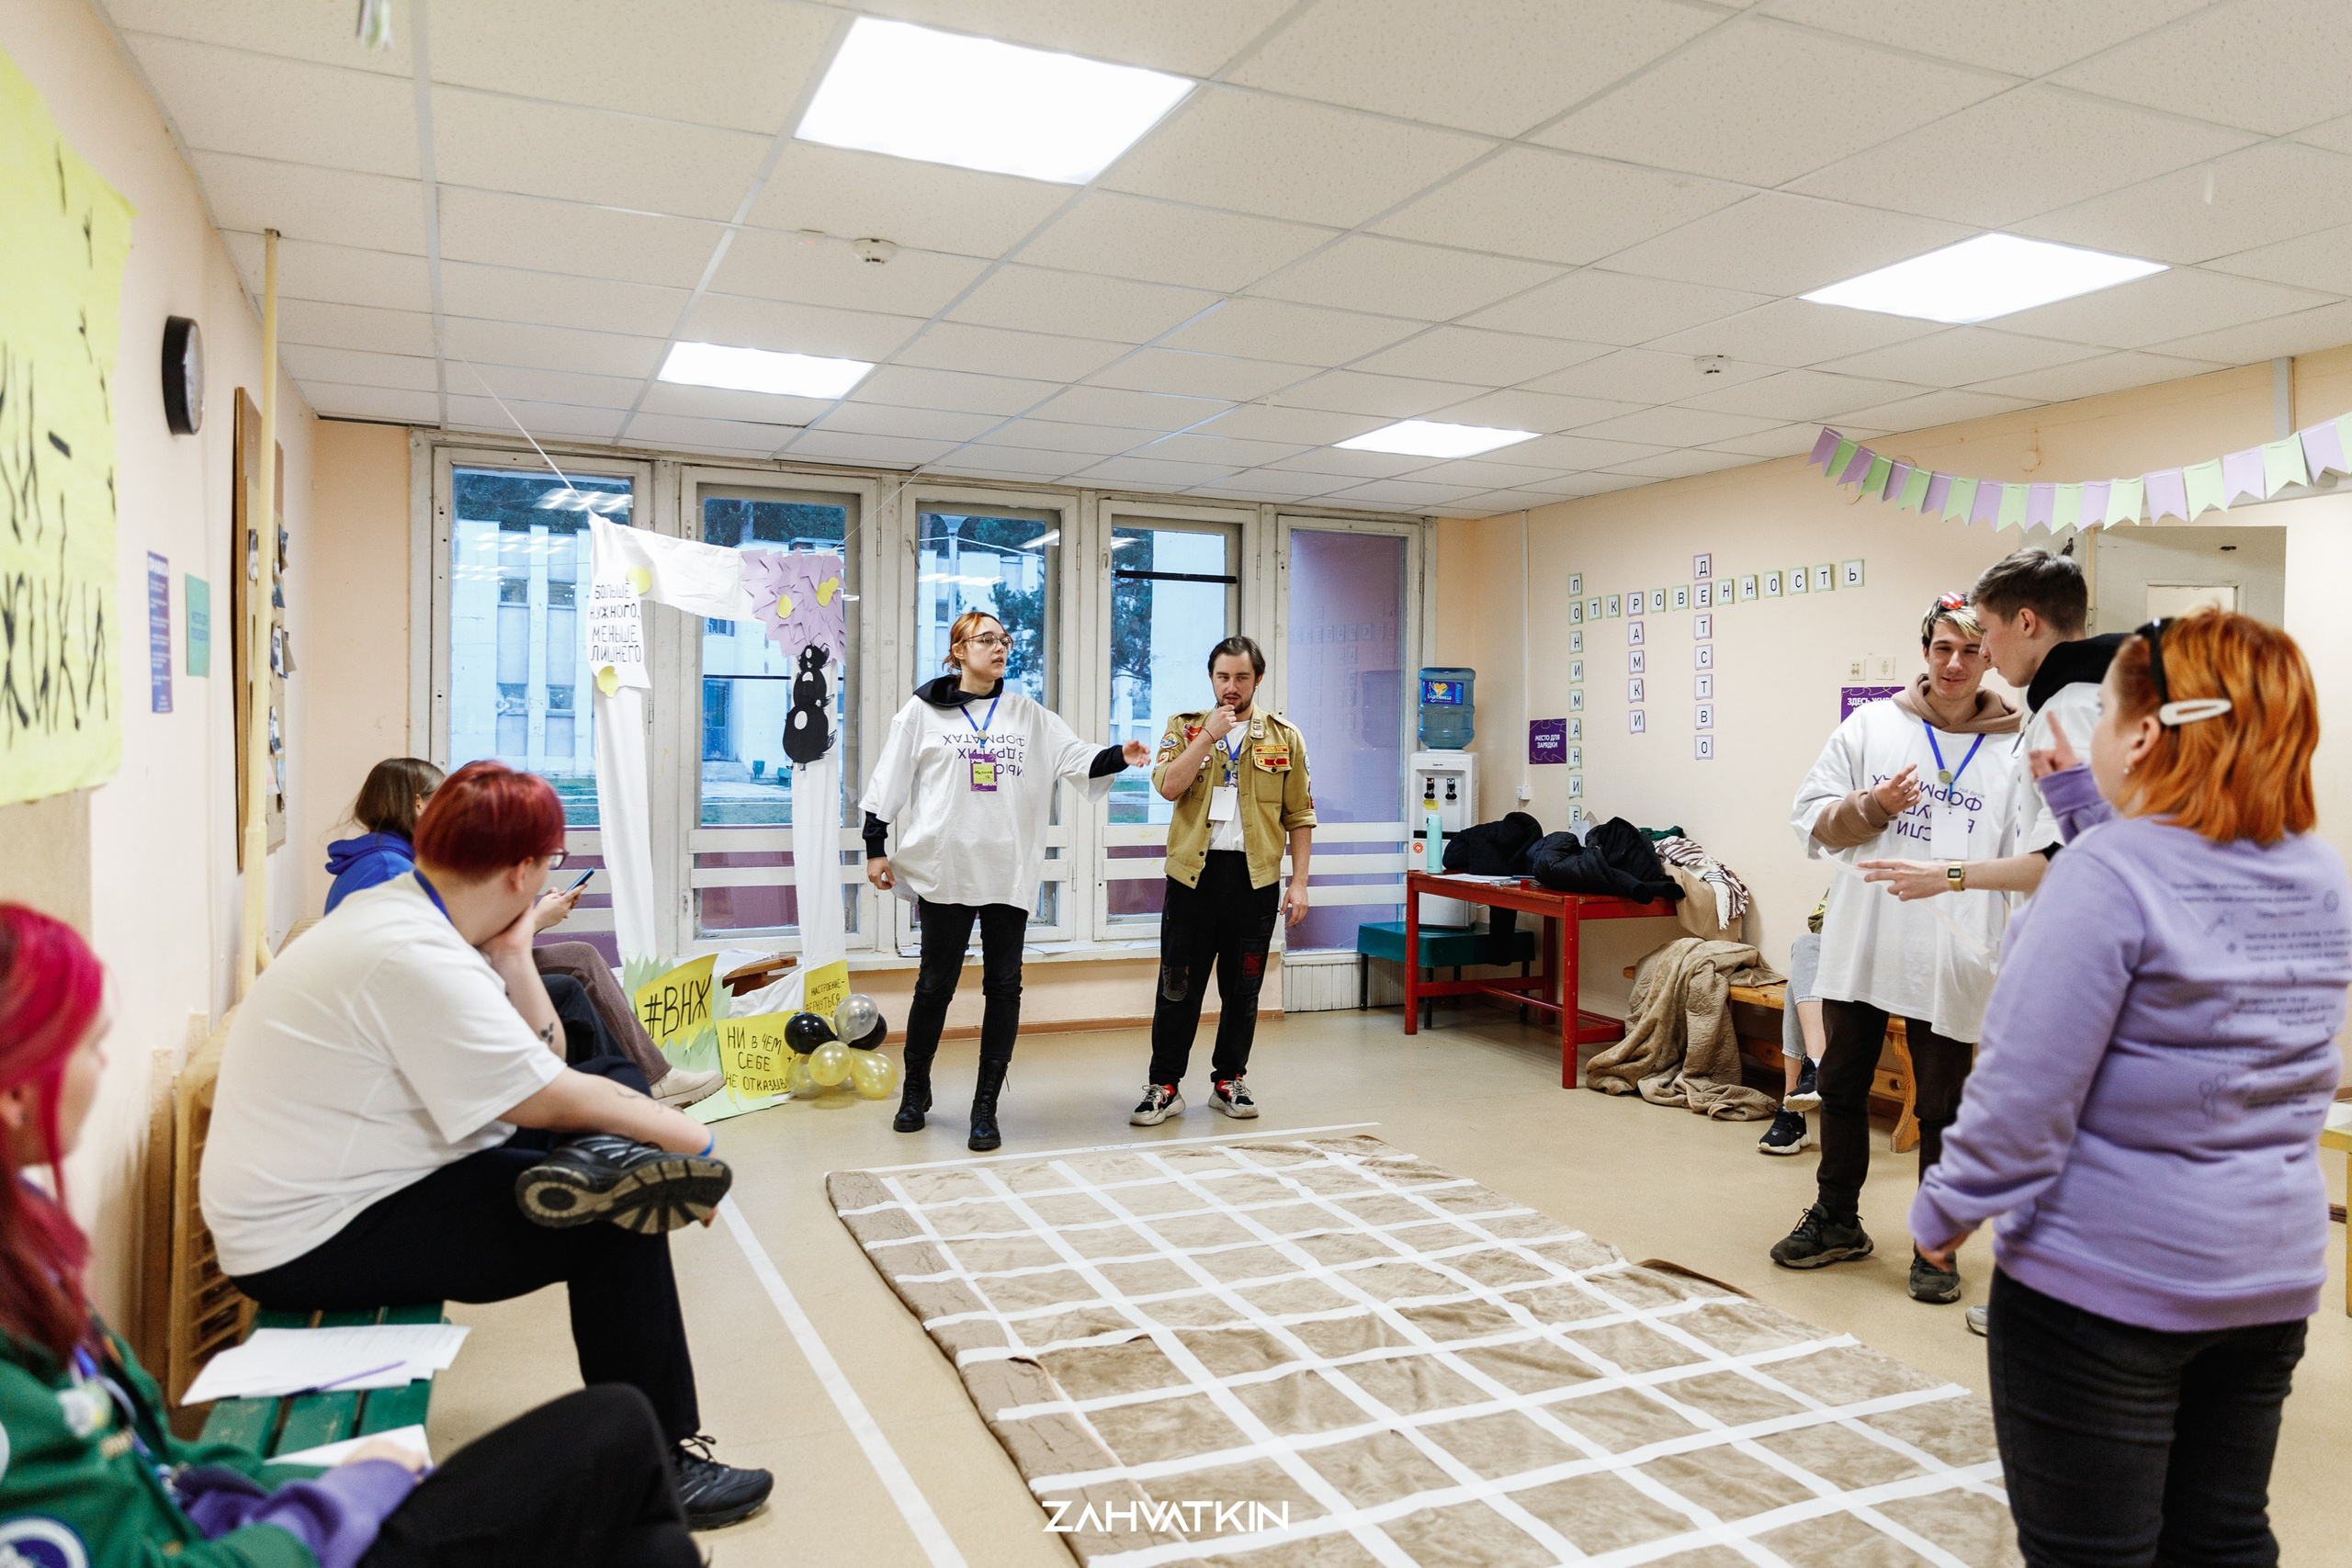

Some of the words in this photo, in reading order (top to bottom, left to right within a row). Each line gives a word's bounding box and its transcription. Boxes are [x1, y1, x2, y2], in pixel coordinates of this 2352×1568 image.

[594, 581, 631, 600] БОЛЬШЕ
[1572, 565, 1859, 622] ОТКРОВЕННОСТЬ
[592, 625, 639, 643] МЕНЬШЕ
[590, 644, 642, 663] ЛИШНЕГО
[1631, 596, 1644, 729] РАМКИ
[644, 973, 713, 1039] #ВНЖ
[727, 1026, 746, 1050] НИ
[762, 1032, 783, 1055] ЧЕМ
[737, 1051, 772, 1073] СЕБЕ
[725, 1070, 739, 1089] НЕ
